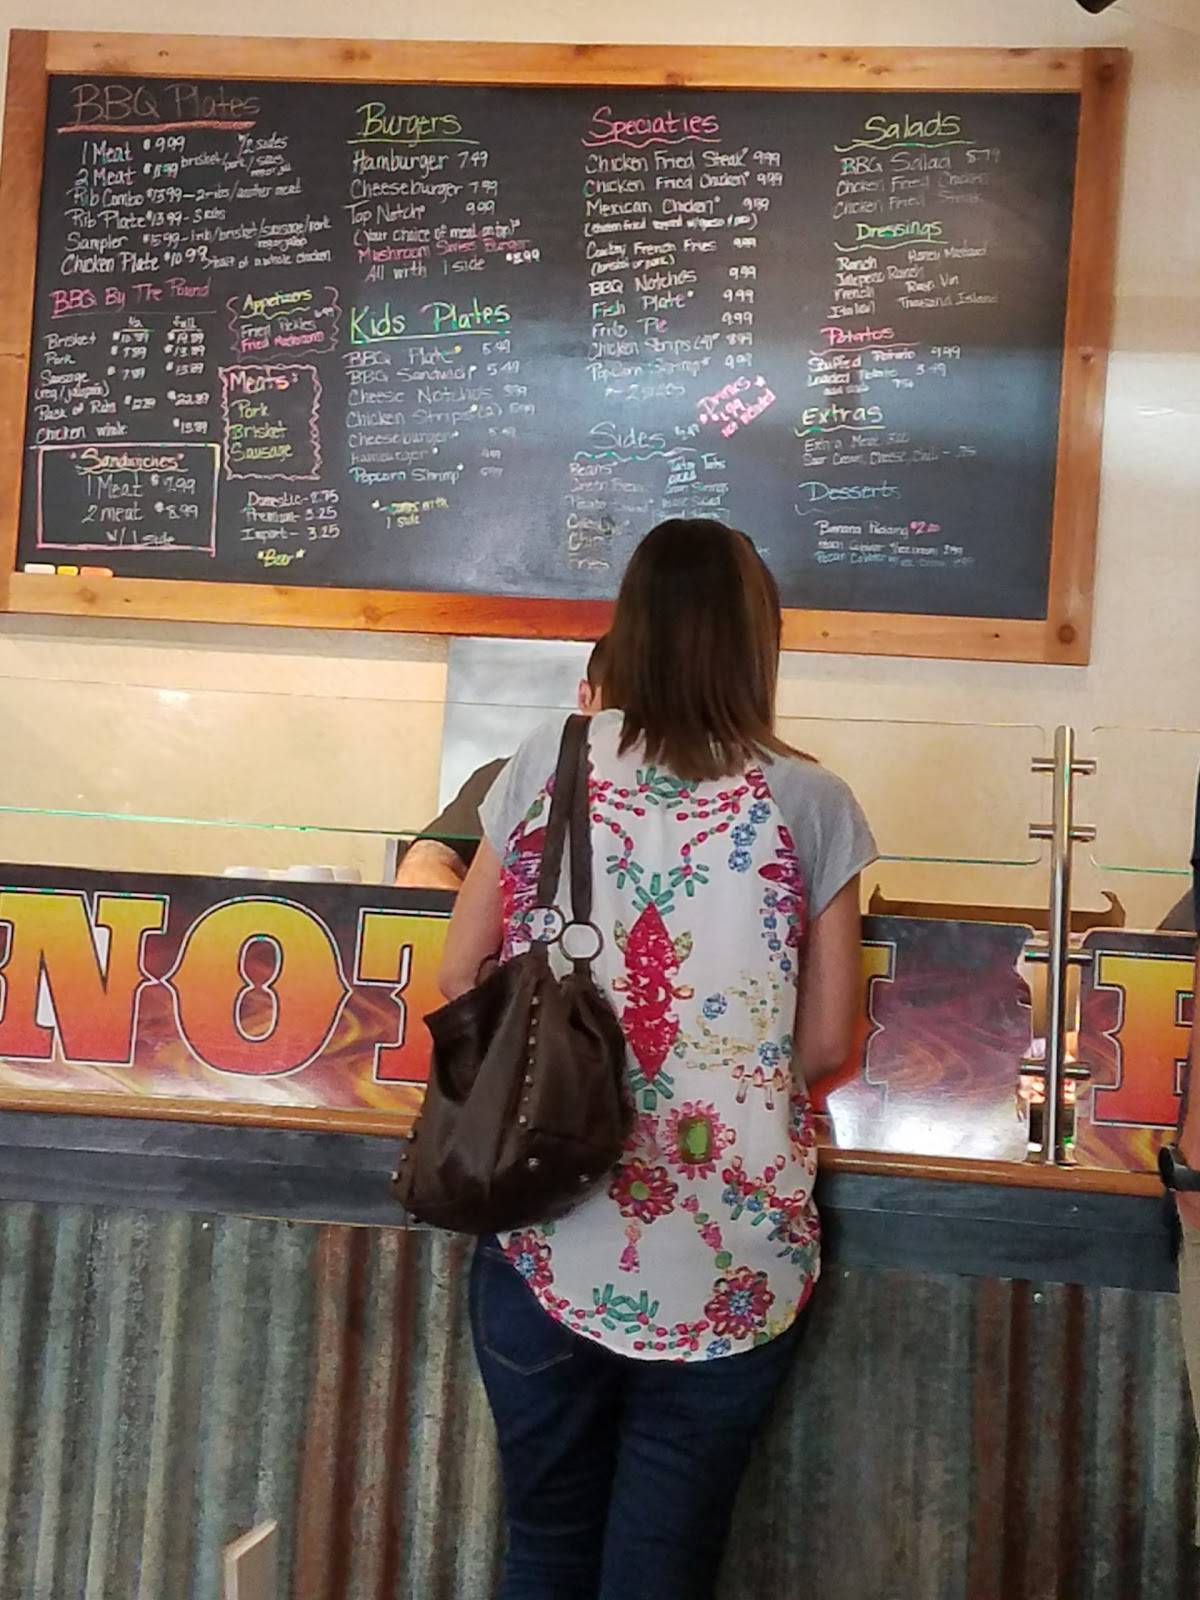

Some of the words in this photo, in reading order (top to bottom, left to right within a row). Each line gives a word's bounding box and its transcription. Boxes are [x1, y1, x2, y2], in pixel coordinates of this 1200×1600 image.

[70, 83, 160, 124] BBQ
[165, 84, 260, 119] Plates
[356, 102, 463, 147] Burgers
[852, 111, 961, 143] Salads
[93, 140, 133, 164] Meat
[352, 148, 449, 179] Hamburger
[585, 153, 649, 174] Chicken
[654, 150, 695, 171] Fried
[840, 156, 883, 176] BBQ
[890, 151, 951, 172] Salad
[93, 164, 137, 187] Meat
[583, 179, 645, 198] Chicken
[655, 174, 693, 191] Fried
[66, 186, 99, 207] Rib
[102, 188, 145, 208] Combo
[351, 179, 464, 203] Cheeseburger
[344, 200, 372, 225] Top
[586, 198, 653, 217] Mexican
[64, 208, 97, 229] Rib
[98, 208, 147, 231] Plate
[856, 220, 943, 241] Dressings
[64, 233, 128, 256] Sampler
[392, 228, 431, 243] choice
[60, 252, 114, 277] Chicken
[118, 252, 160, 274] Plate
[358, 245, 431, 264] Mushroom
[836, 255, 878, 271] Ranch
[365, 263, 385, 282] All
[392, 260, 427, 279] with
[451, 254, 487, 273] side
[886, 265, 924, 280] Ranch
[104, 287, 126, 313] By
[165, 276, 212, 298] Pound
[589, 279, 624, 297] BBQ
[592, 299, 626, 320] Fish
[641, 291, 686, 312] Plate
[240, 323, 271, 339] Fried
[351, 302, 406, 343] Kids
[419, 297, 511, 332] Plates
[241, 337, 270, 352] Fried
[230, 399, 269, 418] Pork
[347, 388, 405, 406] Cheese
[345, 410, 406, 428] Chicken
[802, 403, 883, 426] Extras
[36, 426, 86, 444] Chicken
[229, 420, 287, 440] Brisket
[589, 421, 667, 449] Sides
[230, 442, 293, 462] Sausage
[97, 472, 144, 499] Meat
[349, 466, 406, 485] Popcorn
[411, 468, 459, 486] Shrimp
[100, 501, 145, 523] meat
[813, 519, 862, 536] Banana
